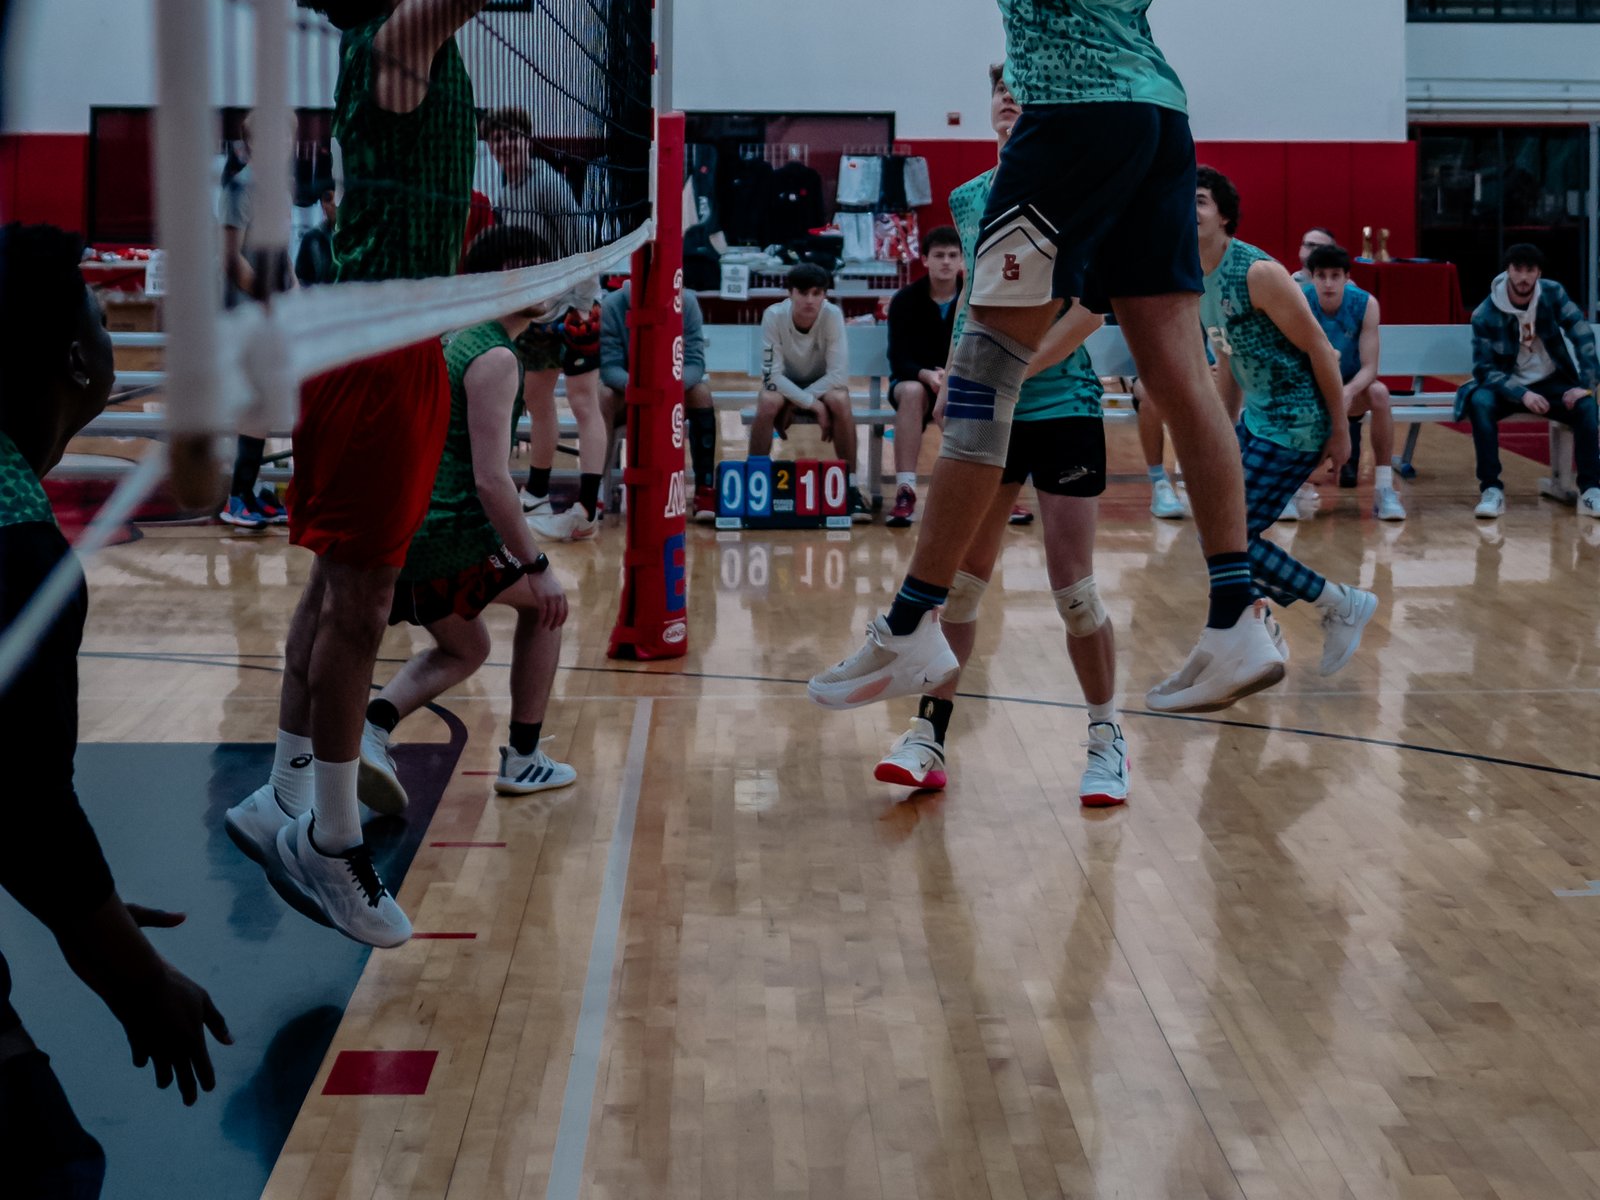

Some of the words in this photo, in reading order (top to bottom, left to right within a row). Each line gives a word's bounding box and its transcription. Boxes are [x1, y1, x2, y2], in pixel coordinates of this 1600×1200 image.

[722, 469, 768, 511] 09
[777, 470, 789, 490] 2
[800, 466, 846, 510] 10
